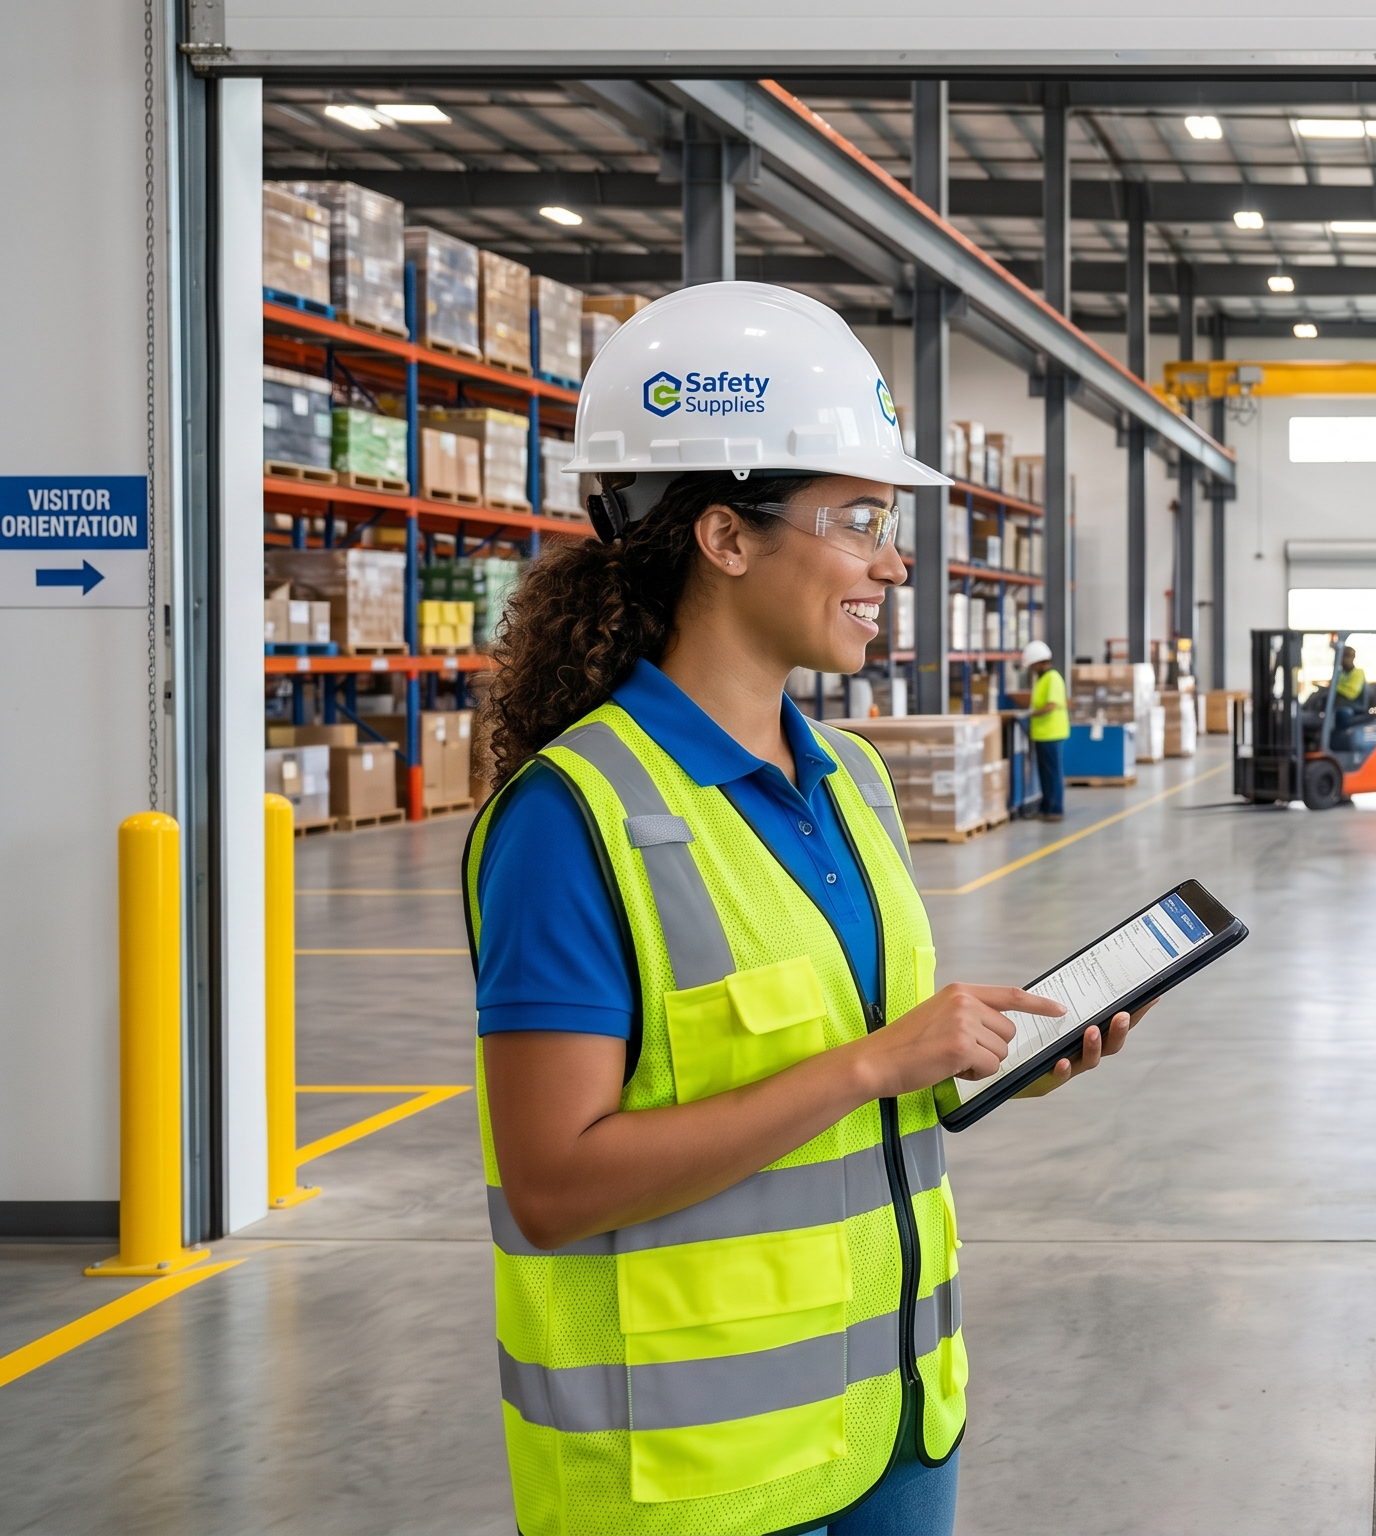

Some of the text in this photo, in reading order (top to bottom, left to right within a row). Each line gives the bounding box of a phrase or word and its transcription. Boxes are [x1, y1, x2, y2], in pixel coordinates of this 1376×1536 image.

[685, 371, 770, 398] Safety
[685, 395, 765, 416] Supplies
[28, 488, 111, 511] VISITOR
[1, 515, 137, 537] ORIENTATION
